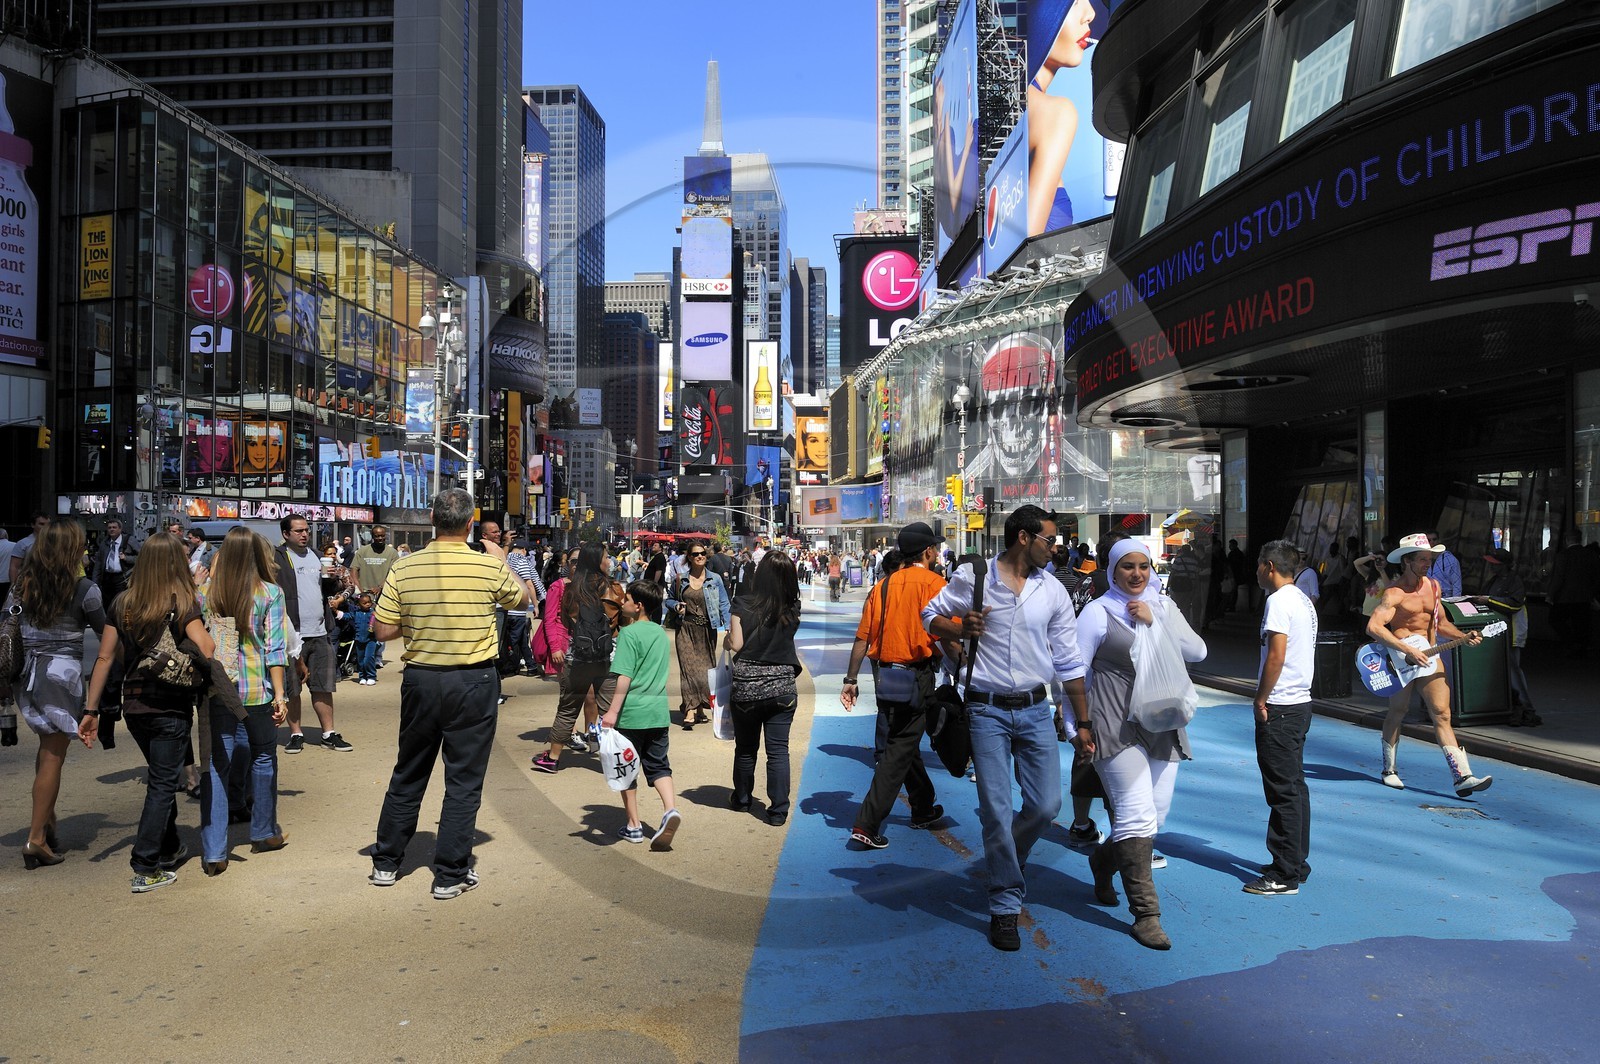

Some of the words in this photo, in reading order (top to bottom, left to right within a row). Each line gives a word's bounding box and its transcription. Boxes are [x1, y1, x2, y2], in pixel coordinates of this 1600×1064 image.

[698, 194, 730, 202] Prudential
[526, 175, 540, 245] TIMES
[1, 223, 25, 238] girls
[88, 230, 106, 244] THE
[1080, 290, 1118, 336] CANCER
[1122, 280, 1134, 311] IN
[1138, 241, 1205, 302] DENYING
[1211, 179, 1323, 264] CUSTODY
[1335, 155, 1381, 208] OF
[84, 248, 109, 268] LION
[83, 268, 109, 289] KING
[684, 282, 713, 291] HSBC
[14, 307, 23, 318] A
[1105, 347, 1127, 382] GET
[1130, 310, 1216, 373] EXECUTIVE
[1222, 276, 1315, 339] AWARD
[755, 406, 771, 415] Light
[508, 425, 520, 483] Kodak
[1003, 484, 1025, 496] MAY
[1026, 483, 1039, 496] 20
[347, 509, 369, 520] ELEMENT
[613, 757, 637, 779] NY
